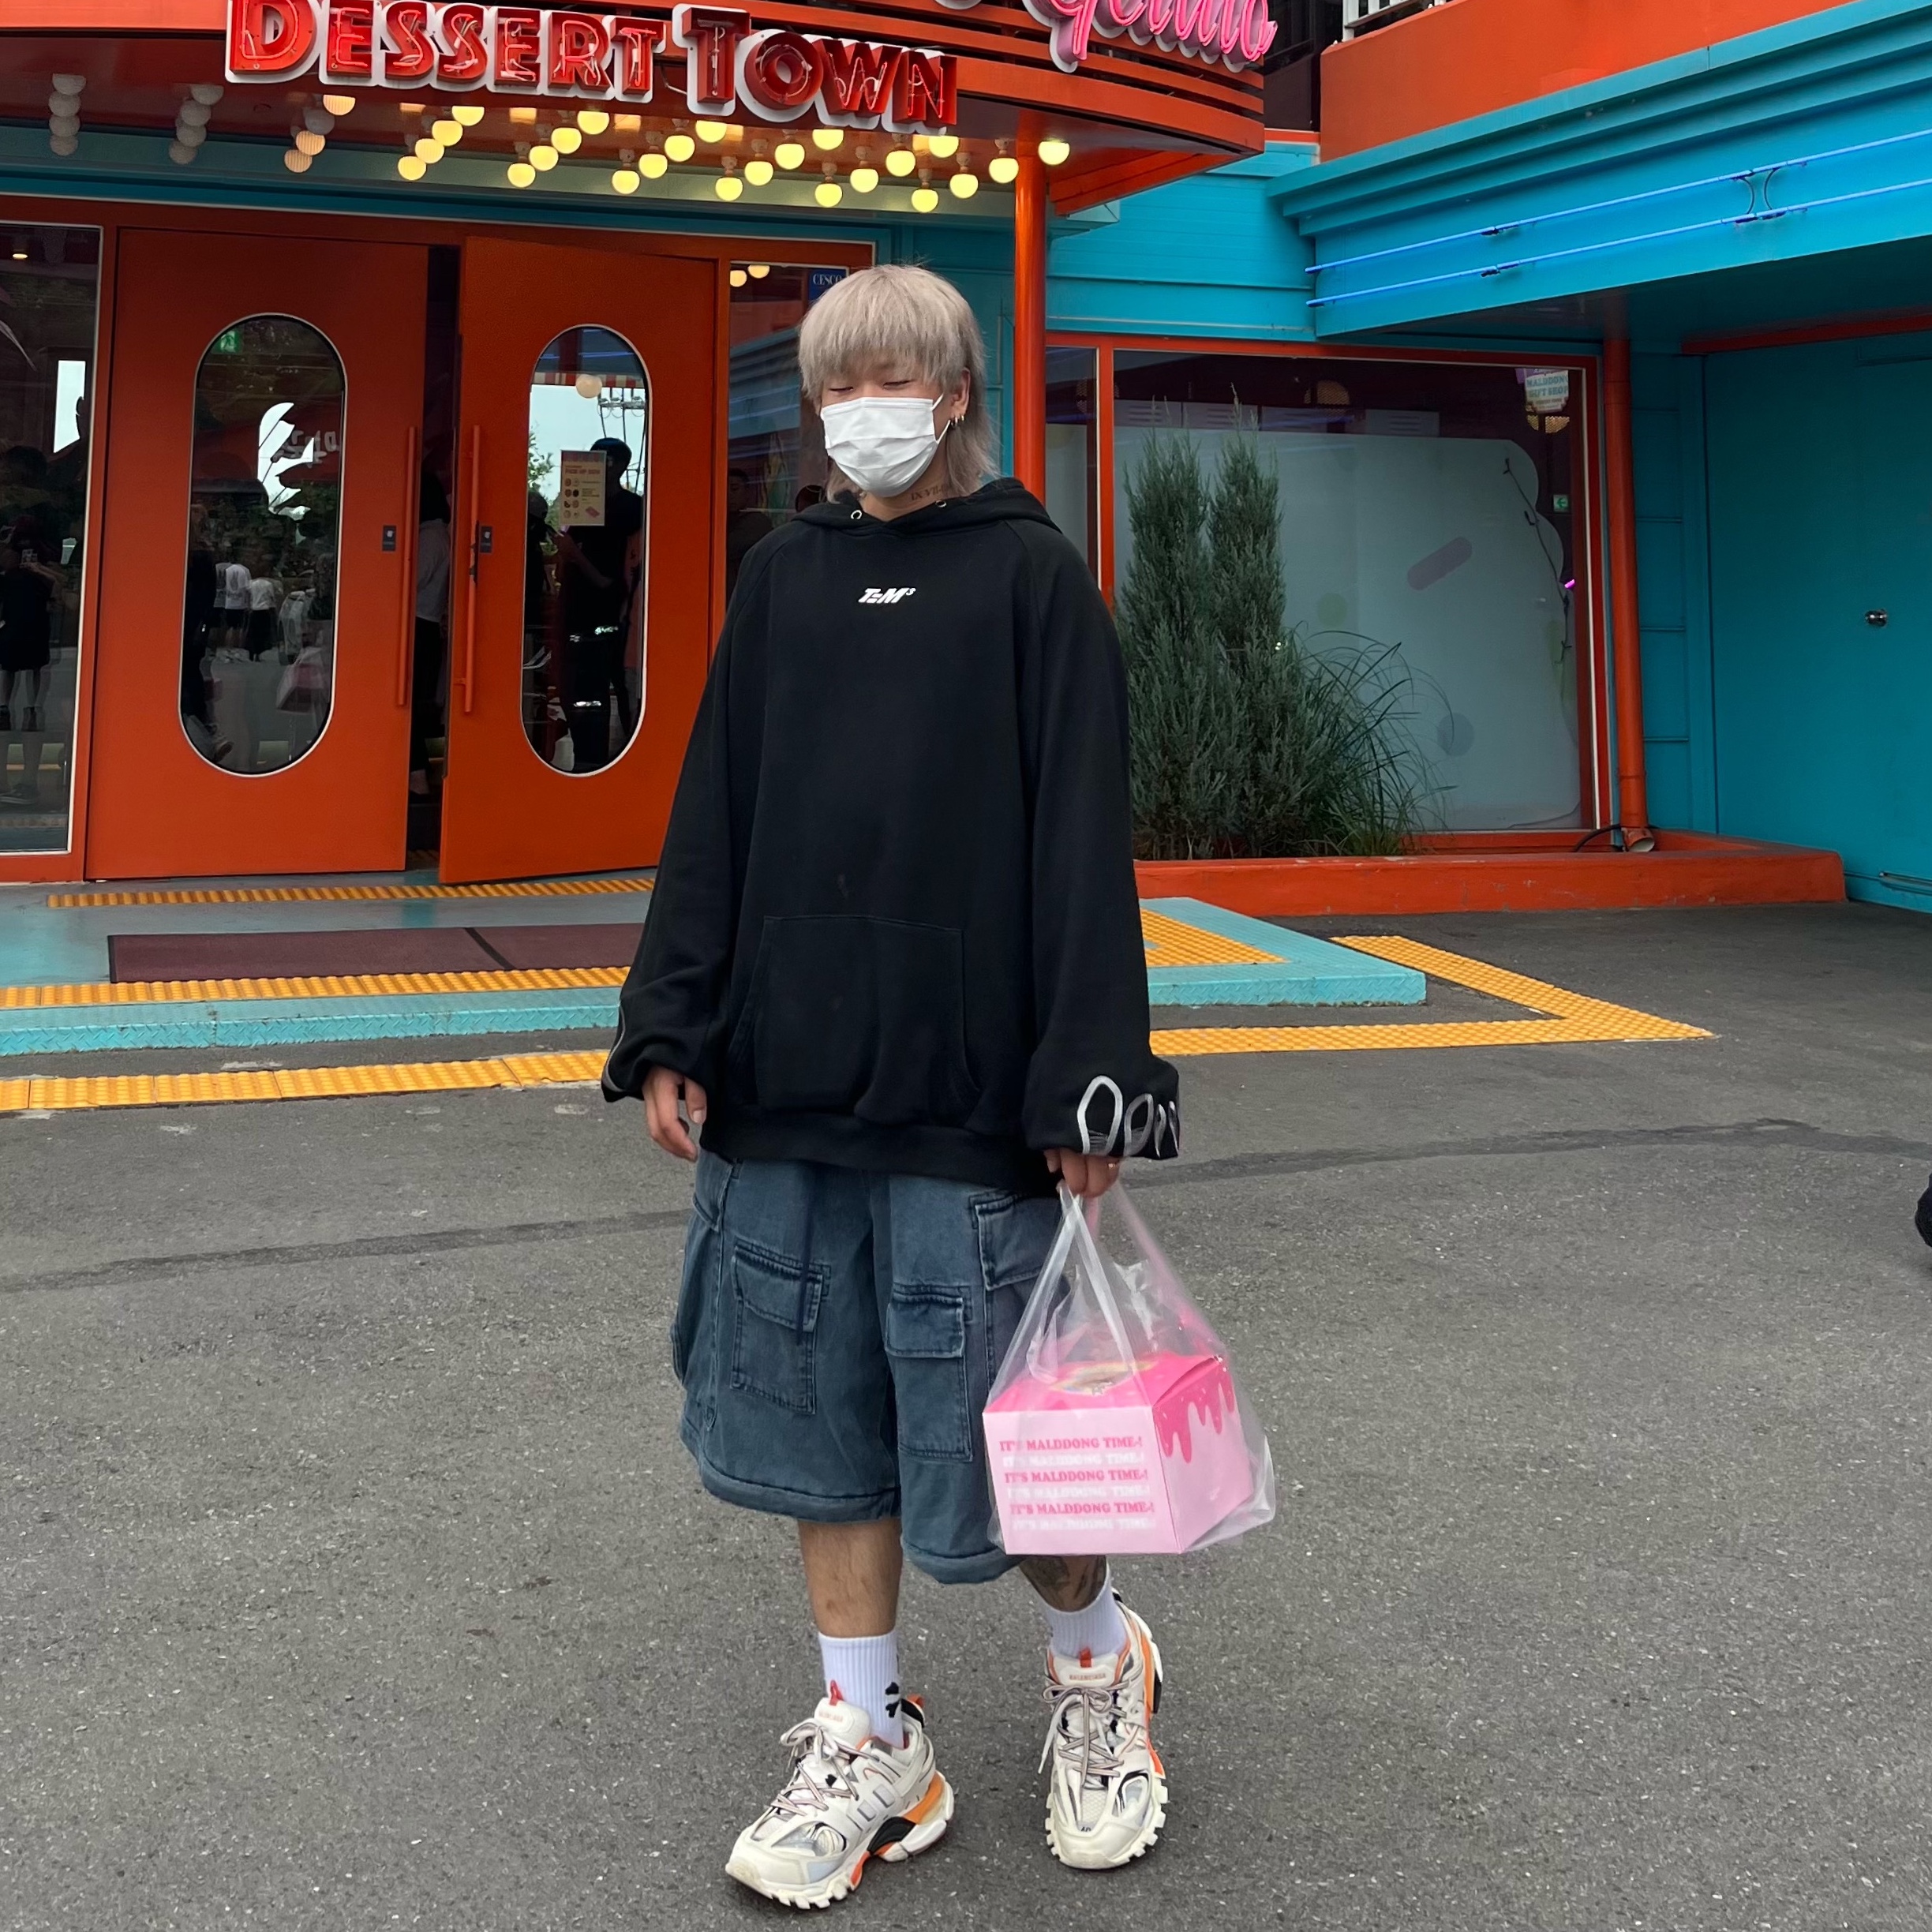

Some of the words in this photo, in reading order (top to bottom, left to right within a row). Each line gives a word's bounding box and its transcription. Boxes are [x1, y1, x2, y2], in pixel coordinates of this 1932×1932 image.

[227, 0, 666, 98] DESSERT
[680, 6, 957, 128] TOWN
[1027, 1438, 1100, 1451] MALDDONG
[1005, 1472, 1028, 1484] IT'S
[1032, 1470, 1105, 1483] MALDDONG
[1010, 1504, 1034, 1515] IT'S
[1037, 1503, 1111, 1515] MALDDONG
